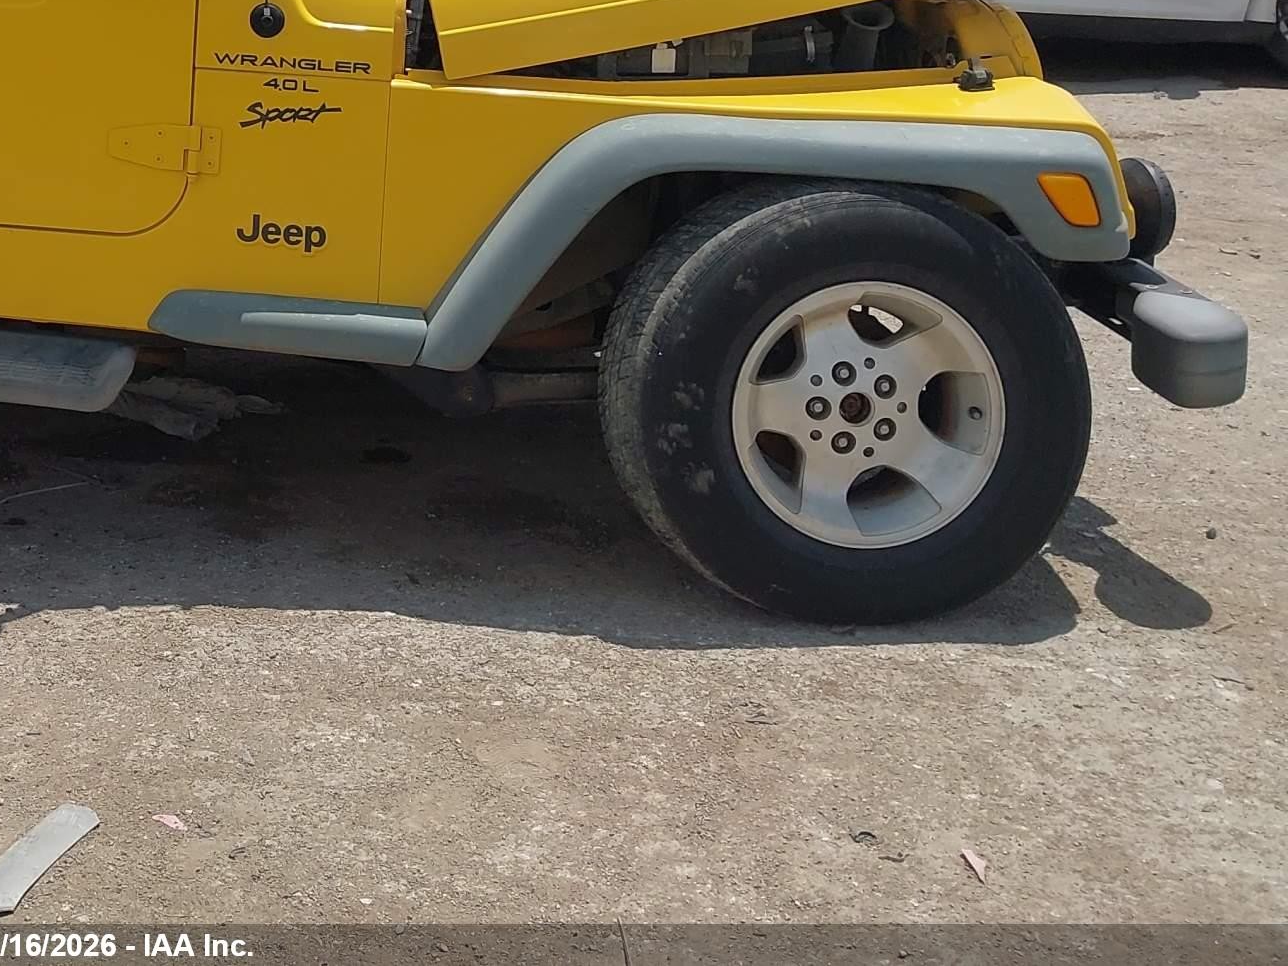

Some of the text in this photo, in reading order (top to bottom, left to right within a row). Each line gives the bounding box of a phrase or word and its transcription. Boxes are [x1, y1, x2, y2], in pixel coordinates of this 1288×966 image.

[214, 52, 371, 74] WRANGLER
[239, 101, 342, 129] Sport
[236, 214, 327, 253] Jeep
